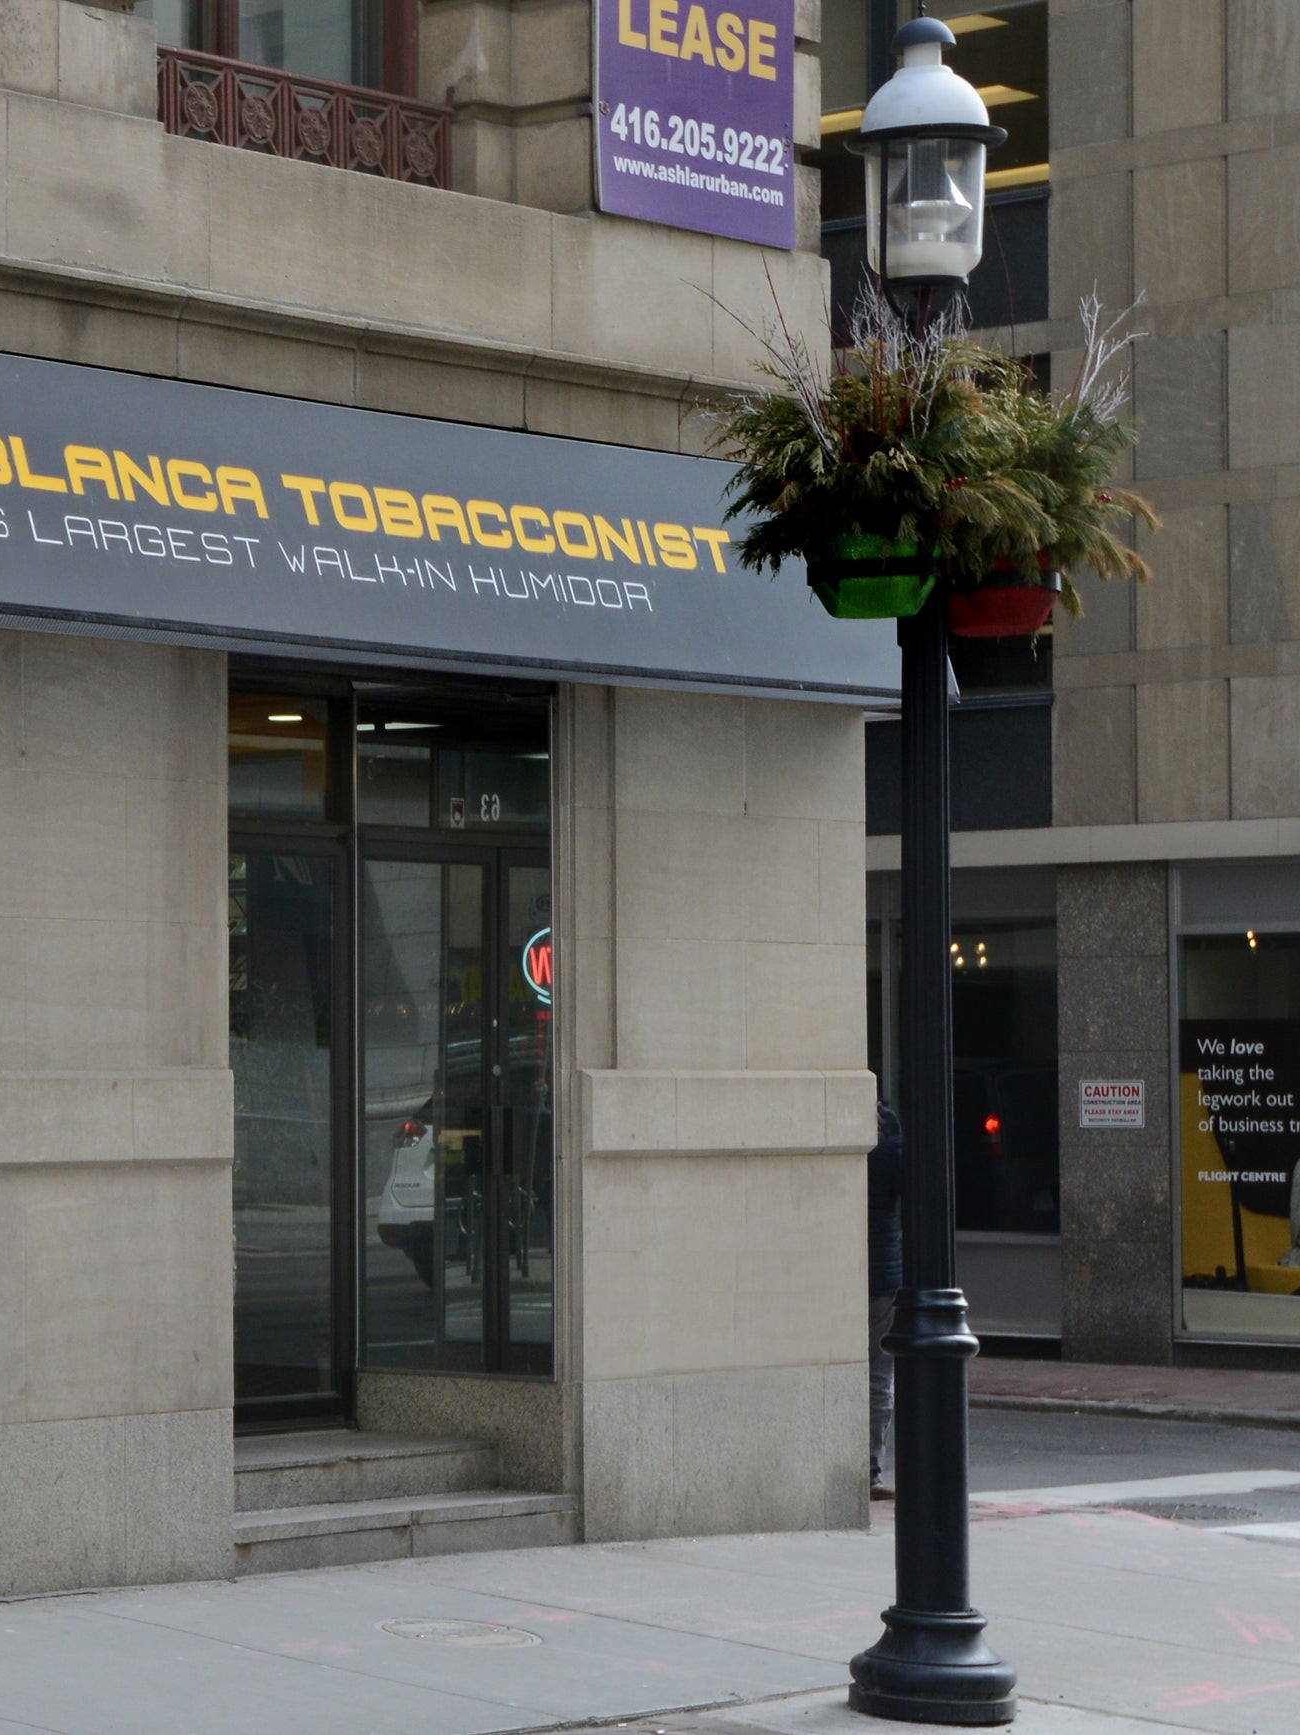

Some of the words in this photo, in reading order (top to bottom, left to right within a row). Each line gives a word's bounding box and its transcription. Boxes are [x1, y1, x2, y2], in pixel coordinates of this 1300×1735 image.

[618, 0, 777, 81] LEASE
[610, 103, 785, 176] 416.205.9222
[613, 155, 785, 207] www.ashlarurban.com
[281, 474, 731, 574] TOBACCONIST
[27, 509, 261, 570] LARGEST
[277, 541, 458, 593] WALK-IN
[467, 564, 654, 612] HUMIDOR
[1197, 1038, 1225, 1055] We
[1230, 1038, 1265, 1055] love
[1198, 1064, 1244, 1086] taking
[1249, 1064, 1275, 1080] the
[1084, 1085, 1140, 1098] CAUTION
[1198, 1090, 1261, 1111] legwork
[1266, 1094, 1294, 1107] out
[1198, 1115, 1215, 1132] of
[1219, 1116, 1284, 1132] business
[1197, 1171, 1240, 1182] FLIGHT
[1240, 1171, 1287, 1183] CENTRE
